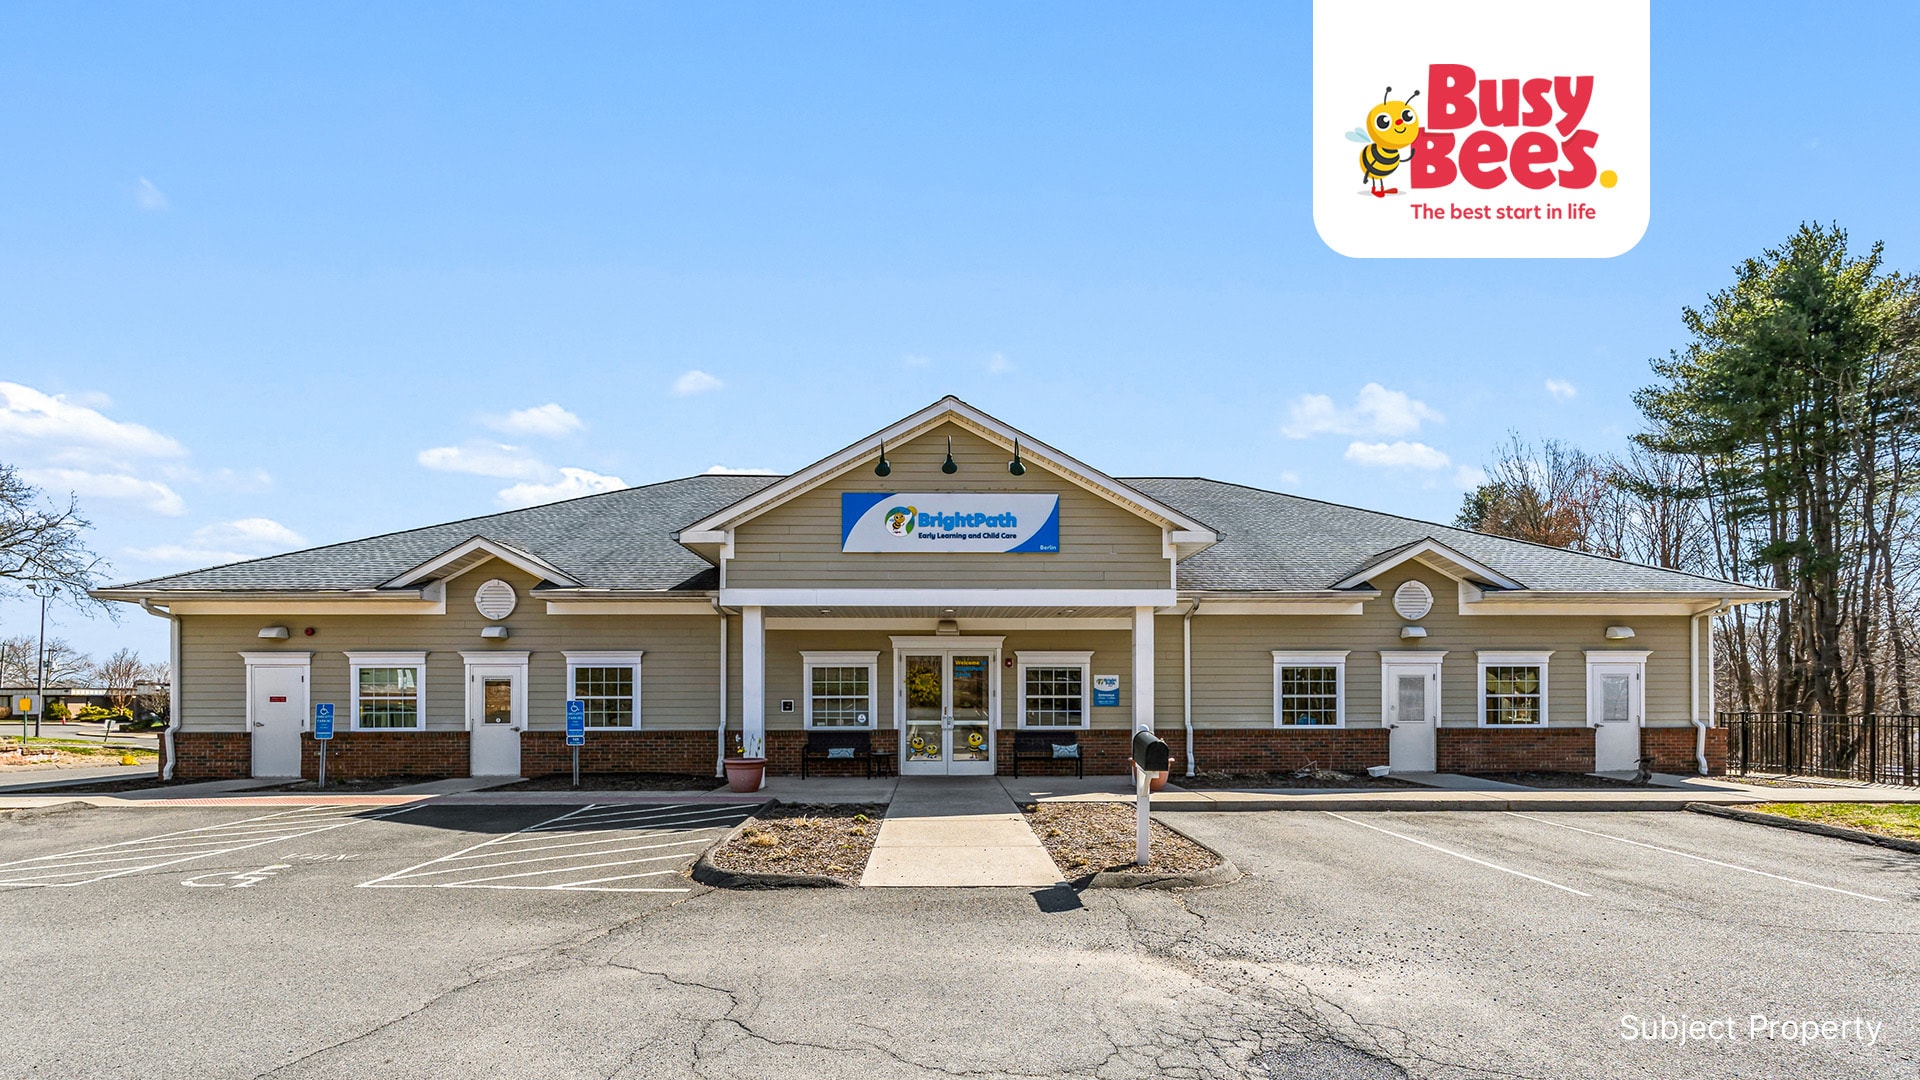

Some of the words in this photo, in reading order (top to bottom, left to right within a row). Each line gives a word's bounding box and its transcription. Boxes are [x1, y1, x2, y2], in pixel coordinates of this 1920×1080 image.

[918, 512, 1018, 531] BrightPath
[918, 532, 936, 540] Early
[937, 532, 967, 540] Learning
